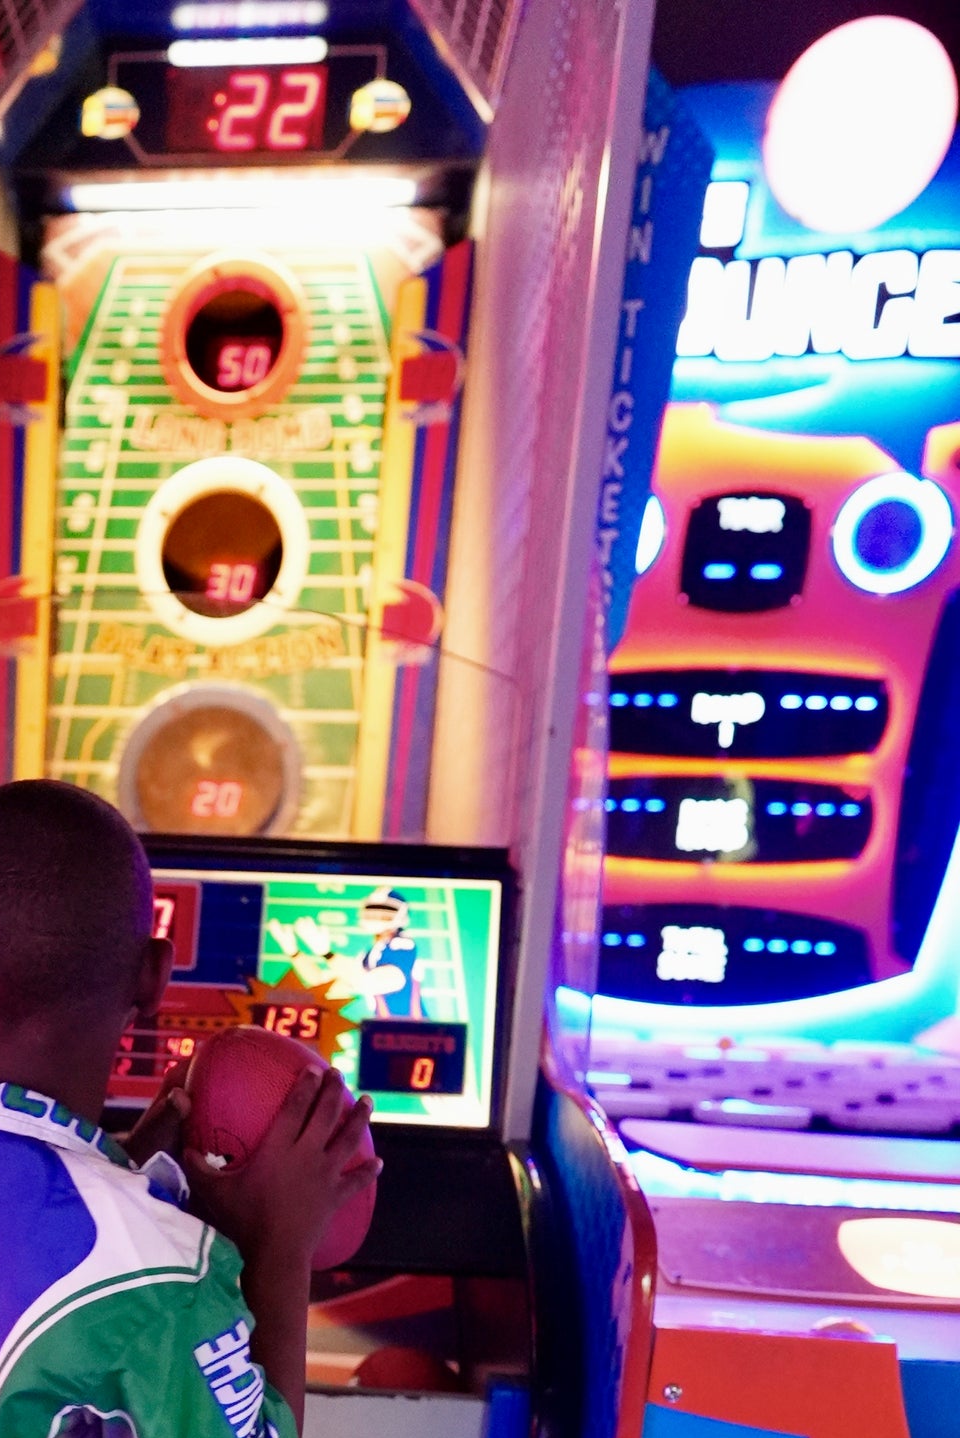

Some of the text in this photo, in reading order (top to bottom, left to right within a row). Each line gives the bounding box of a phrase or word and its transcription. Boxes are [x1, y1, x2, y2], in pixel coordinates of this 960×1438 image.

[217, 344, 271, 387] 50
[207, 564, 257, 602] 30
[192, 781, 242, 817] 20
[264, 1006, 319, 1038] 125
[410, 1058, 434, 1088] 0
